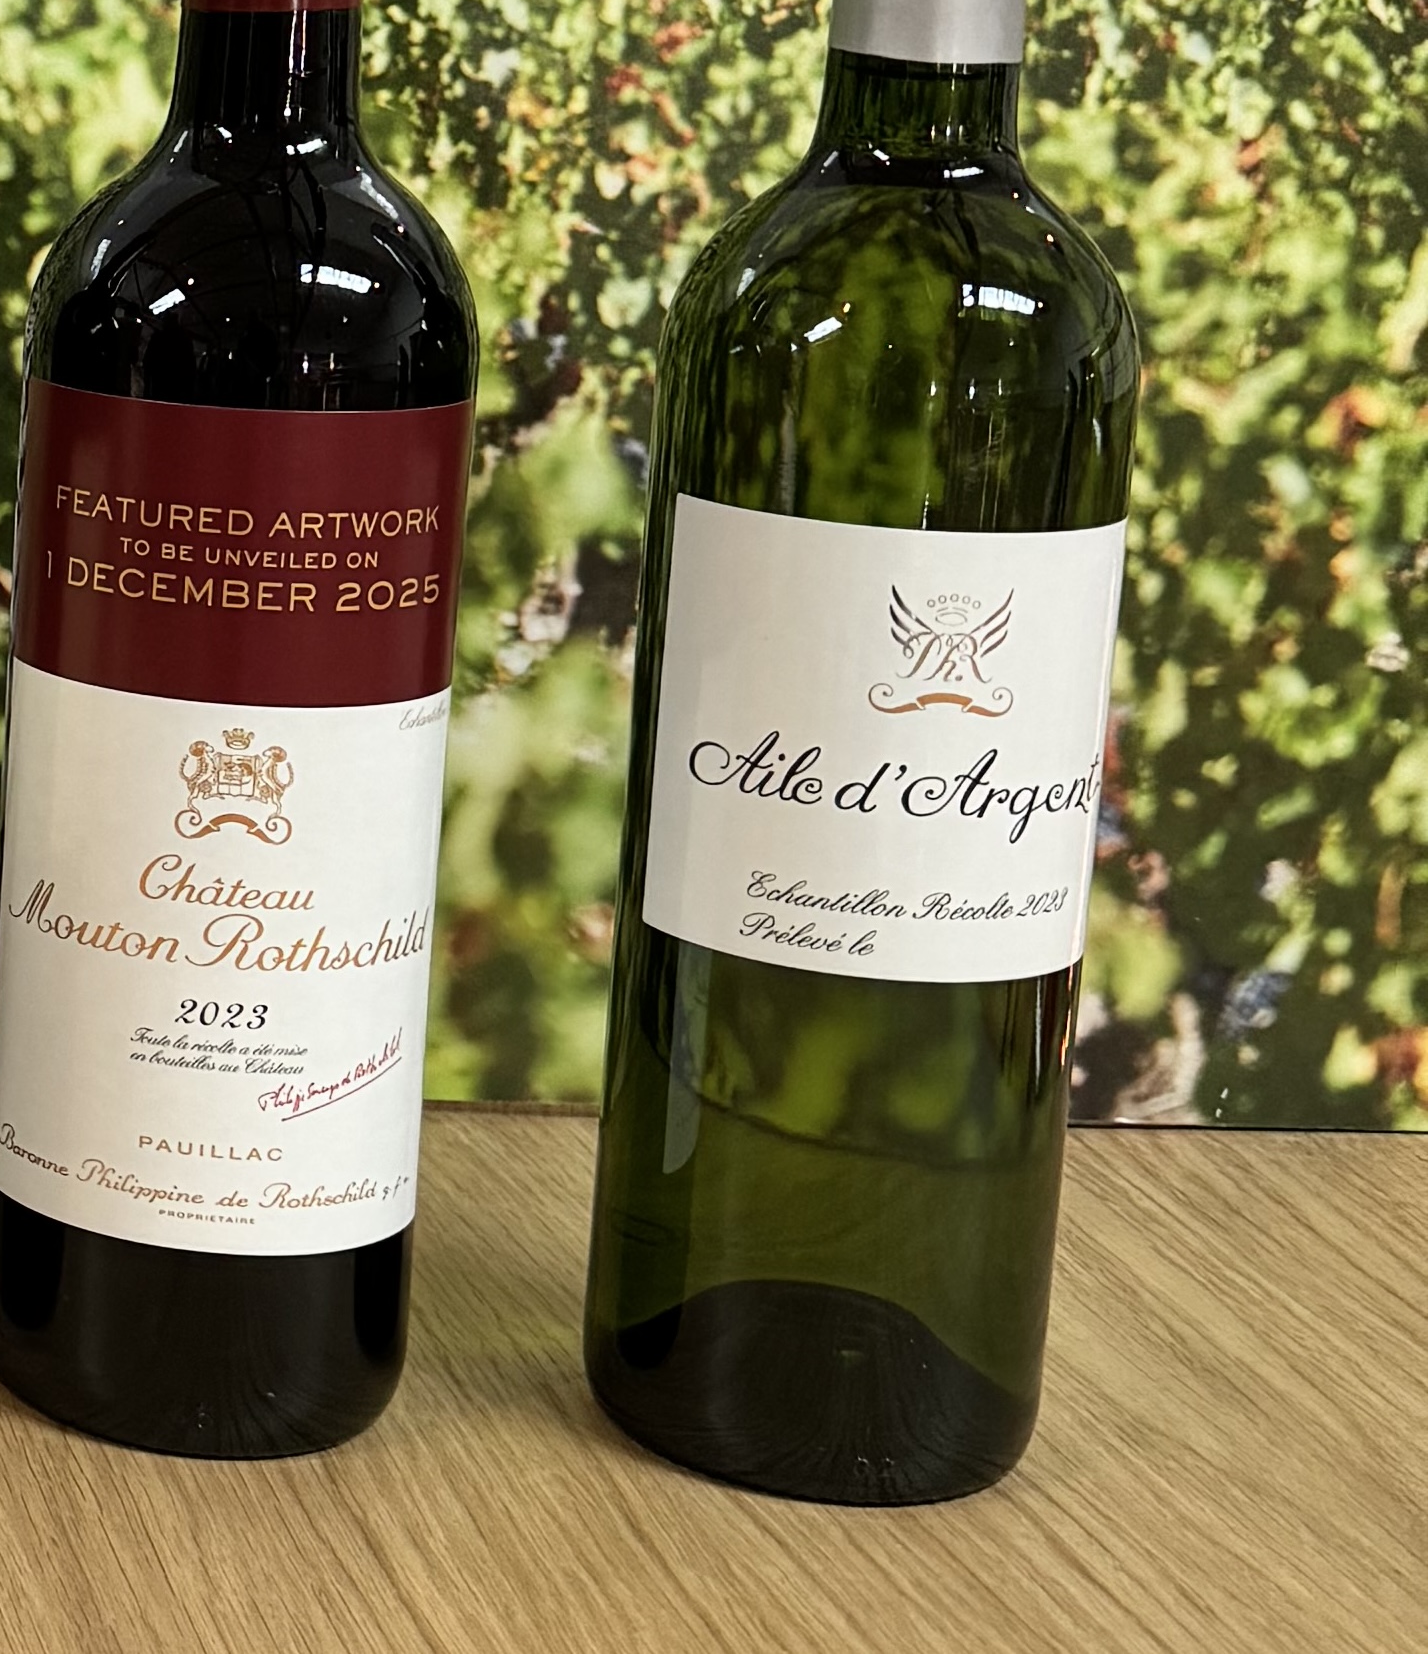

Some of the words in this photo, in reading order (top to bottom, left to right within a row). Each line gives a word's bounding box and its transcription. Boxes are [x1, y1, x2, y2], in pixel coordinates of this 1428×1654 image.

[57, 484, 254, 537] FEATURED
[268, 504, 440, 540] ARTWORK
[119, 536, 151, 557] TO
[161, 542, 194, 562] BE
[205, 547, 337, 569] UNVEILED
[346, 550, 379, 569] ON
[47, 550, 52, 579] 1
[67, 557, 317, 613] DECEMBER
[335, 573, 441, 613] 2025
[688, 730, 823, 806] Aile
[834, 748, 1101, 844] d'Argent
[138, 853, 315, 911] Château
[746, 870, 907, 921] Echantillon
[912, 891, 1014, 922] Récolte
[1015, 886, 1069, 919] 2023
[8, 878, 178, 963] Mouton
[184, 905, 431, 972] Rothschild
[739, 912, 844, 952] Prélevé
[849, 929, 878, 957] le
[174, 998, 269, 1030] 2023
[130, 1027, 172, 1047] Toute
[172, 1034, 189, 1050] la
[274, 1043, 309, 1057] mise
[148, 1050, 216, 1072] bouteilles
[218, 1063, 240, 1074] au
[137, 1135, 283, 1161] PAUILLAC
[76, 1158, 205, 1205] Philippine
[215, 1190, 249, 1208] de
[258, 1178, 378, 1209] Rothschild
